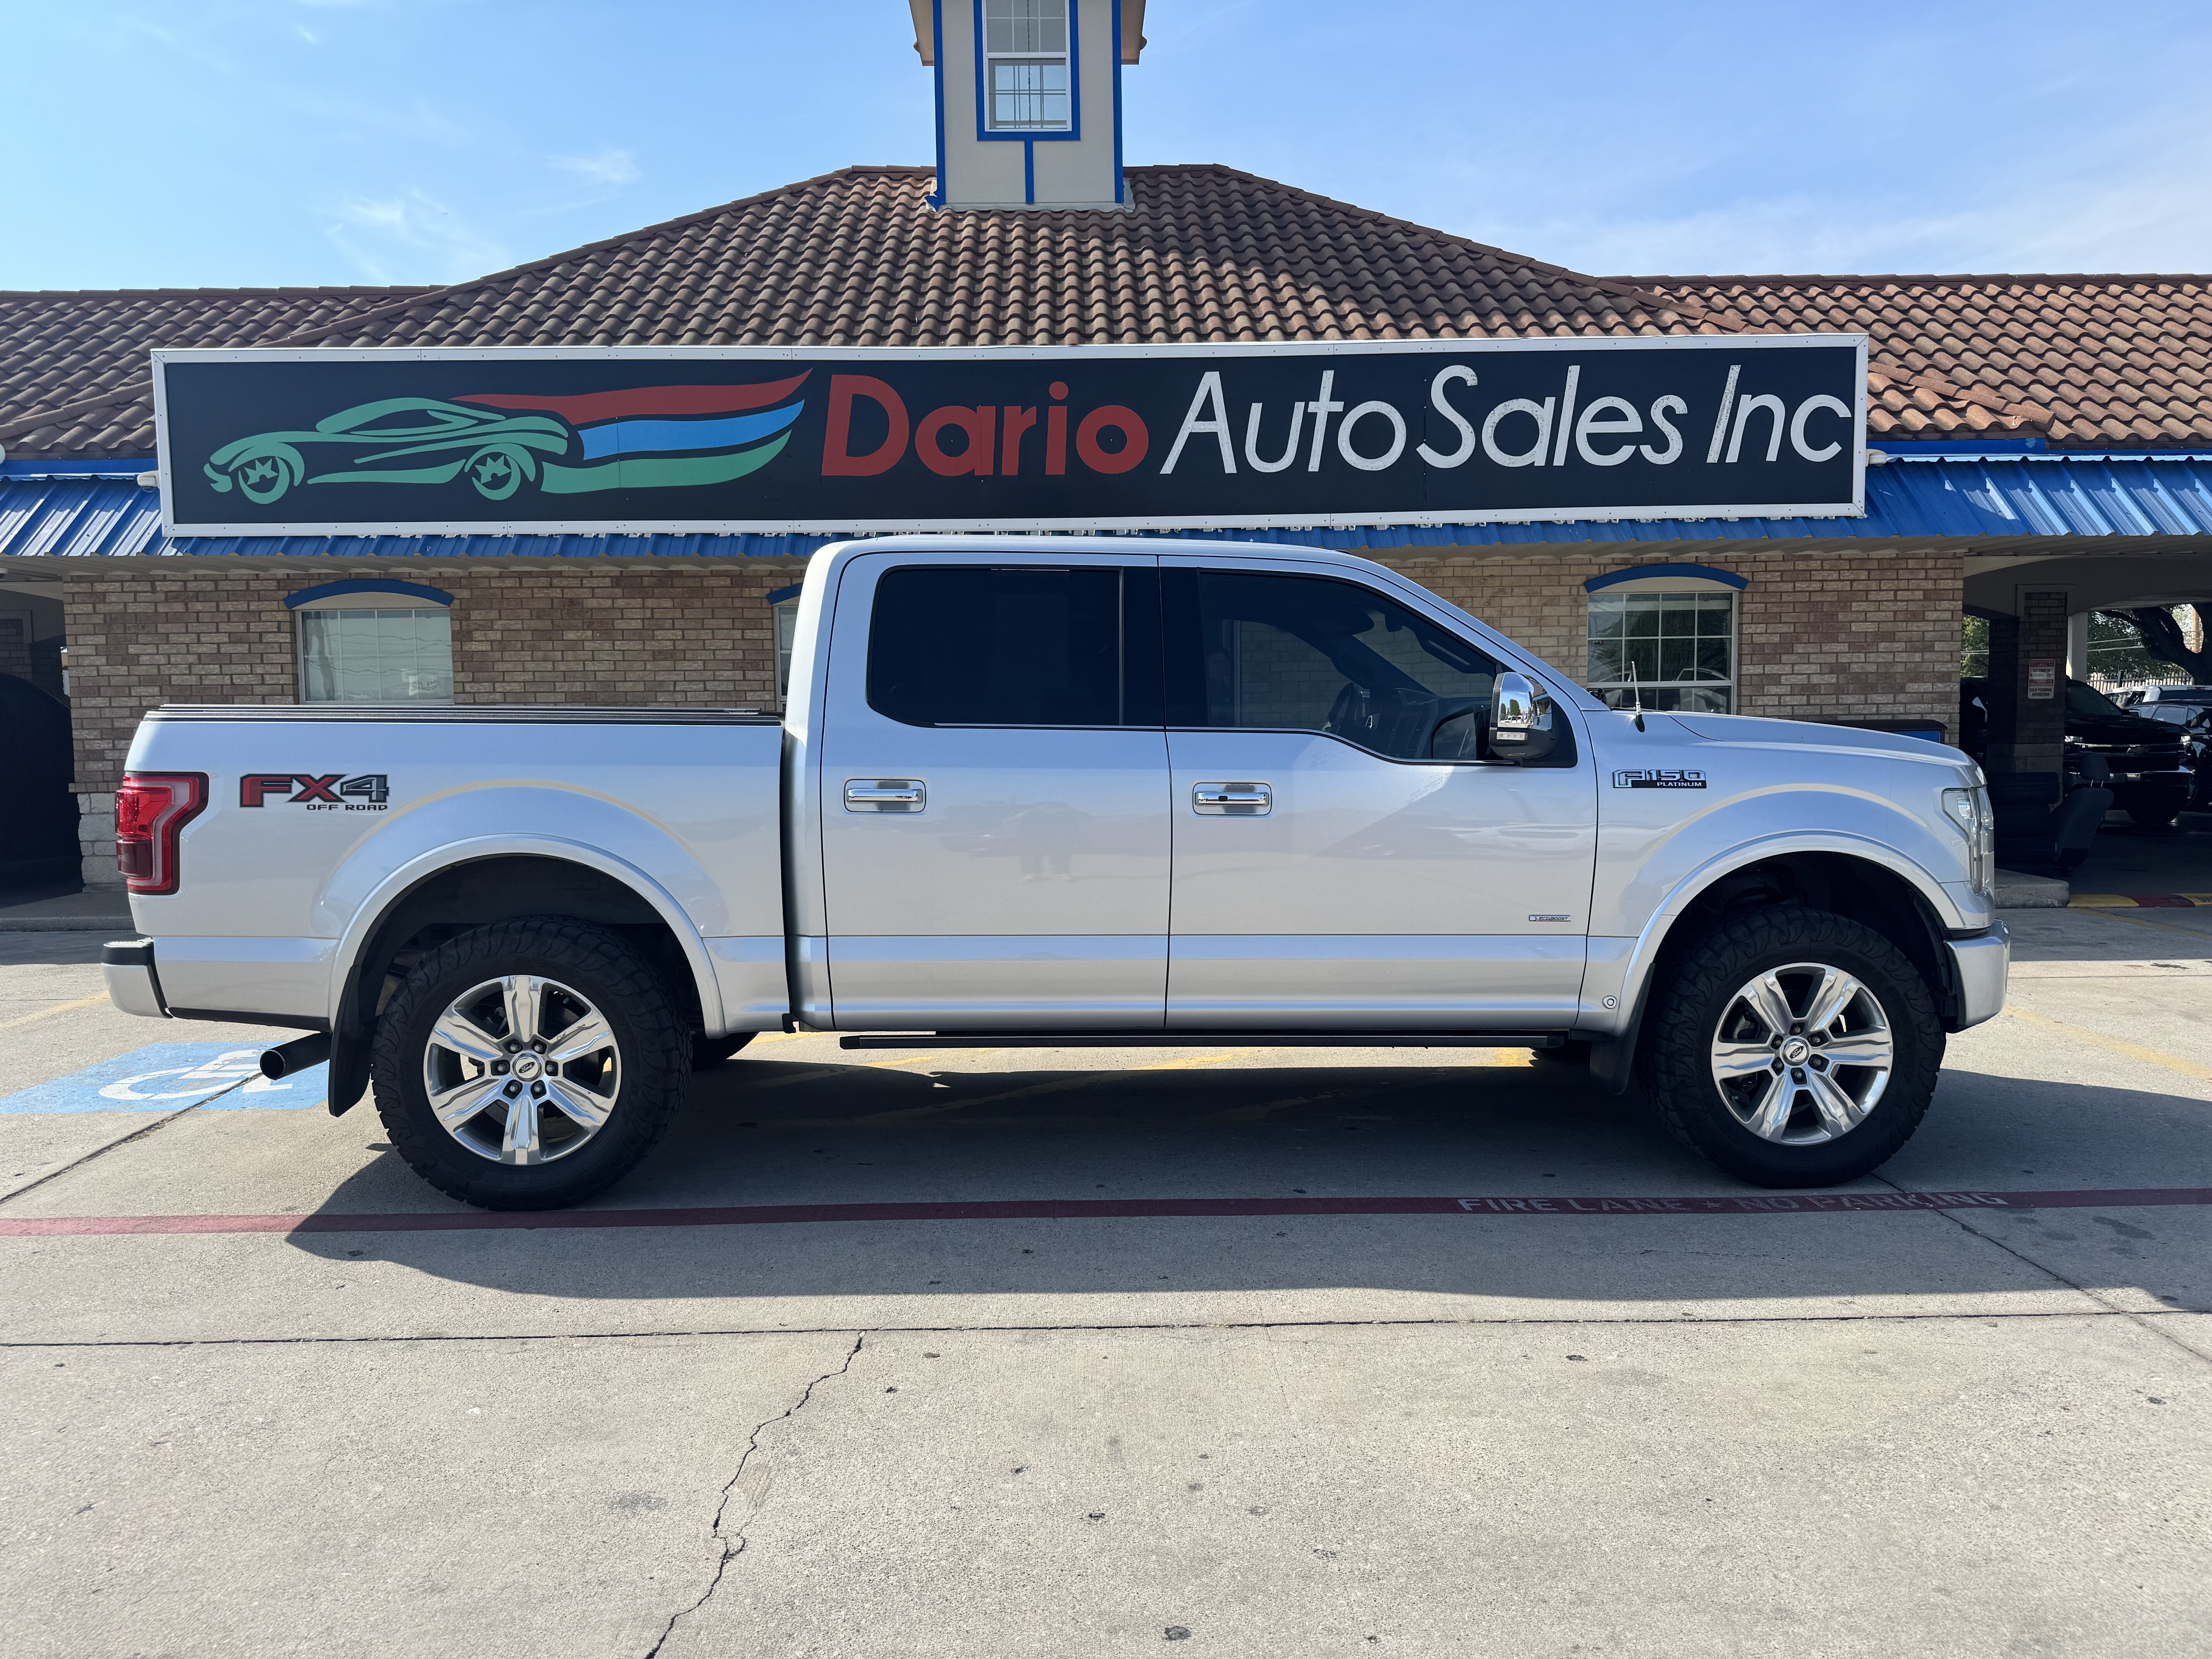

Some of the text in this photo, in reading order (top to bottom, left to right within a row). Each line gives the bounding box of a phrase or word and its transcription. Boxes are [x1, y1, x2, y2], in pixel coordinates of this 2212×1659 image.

[821, 364, 1852, 477] Dario Auto Sales Inc
[239, 774, 390, 808] FX4
[522, 1063, 532, 1072] Ford
[1457, 1192, 2009, 1211] FIRE LANE NO PARKING
